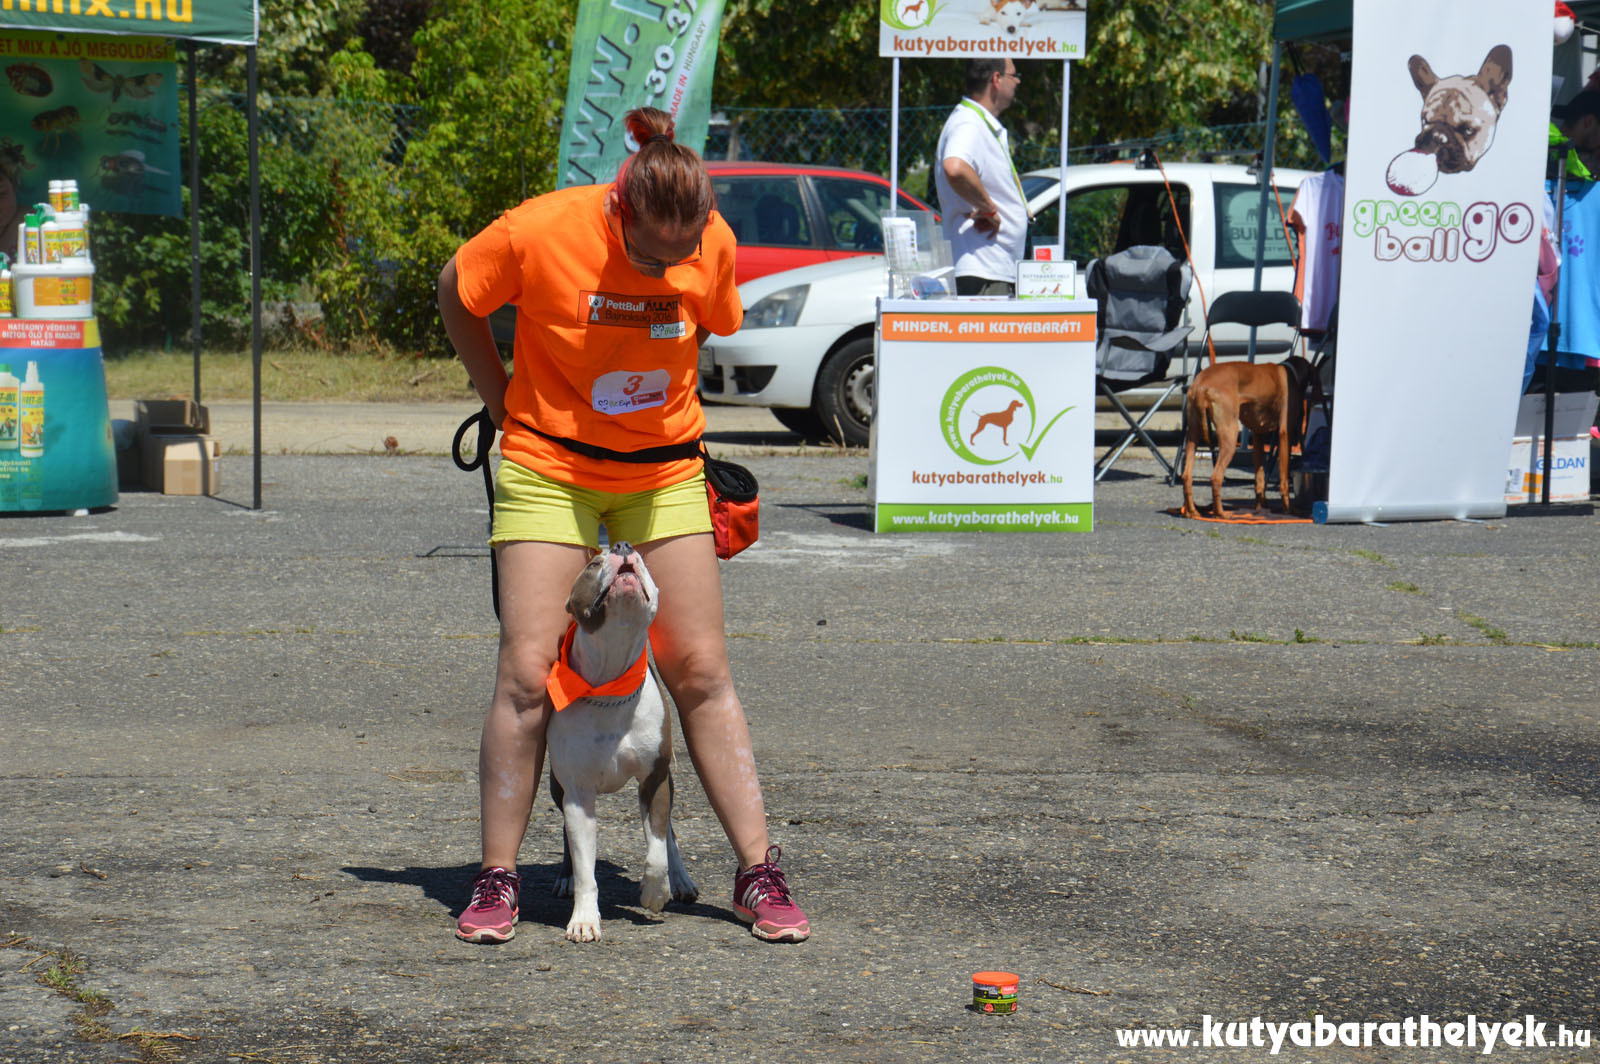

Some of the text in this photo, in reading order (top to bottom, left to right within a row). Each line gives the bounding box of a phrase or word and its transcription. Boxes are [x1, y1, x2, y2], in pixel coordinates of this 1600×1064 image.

[677, 74, 688, 87] IN
[683, 21, 707, 72] HUNGARY
[893, 34, 1078, 55] kutyabarathelyek.hu
[1353, 199, 1462, 237] green
[1374, 226, 1460, 262] ball
[606, 300, 645, 312] PettBull
[892, 320, 953, 334] MINDEN,
[958, 322, 985, 334] AMI
[623, 375, 644, 396] 3
[1535, 457, 1585, 471] GLDAN
[912, 470, 1063, 488] kutyabarathelyek.hu
[892, 510, 1079, 528] www.kutyabarathelyek.hu
